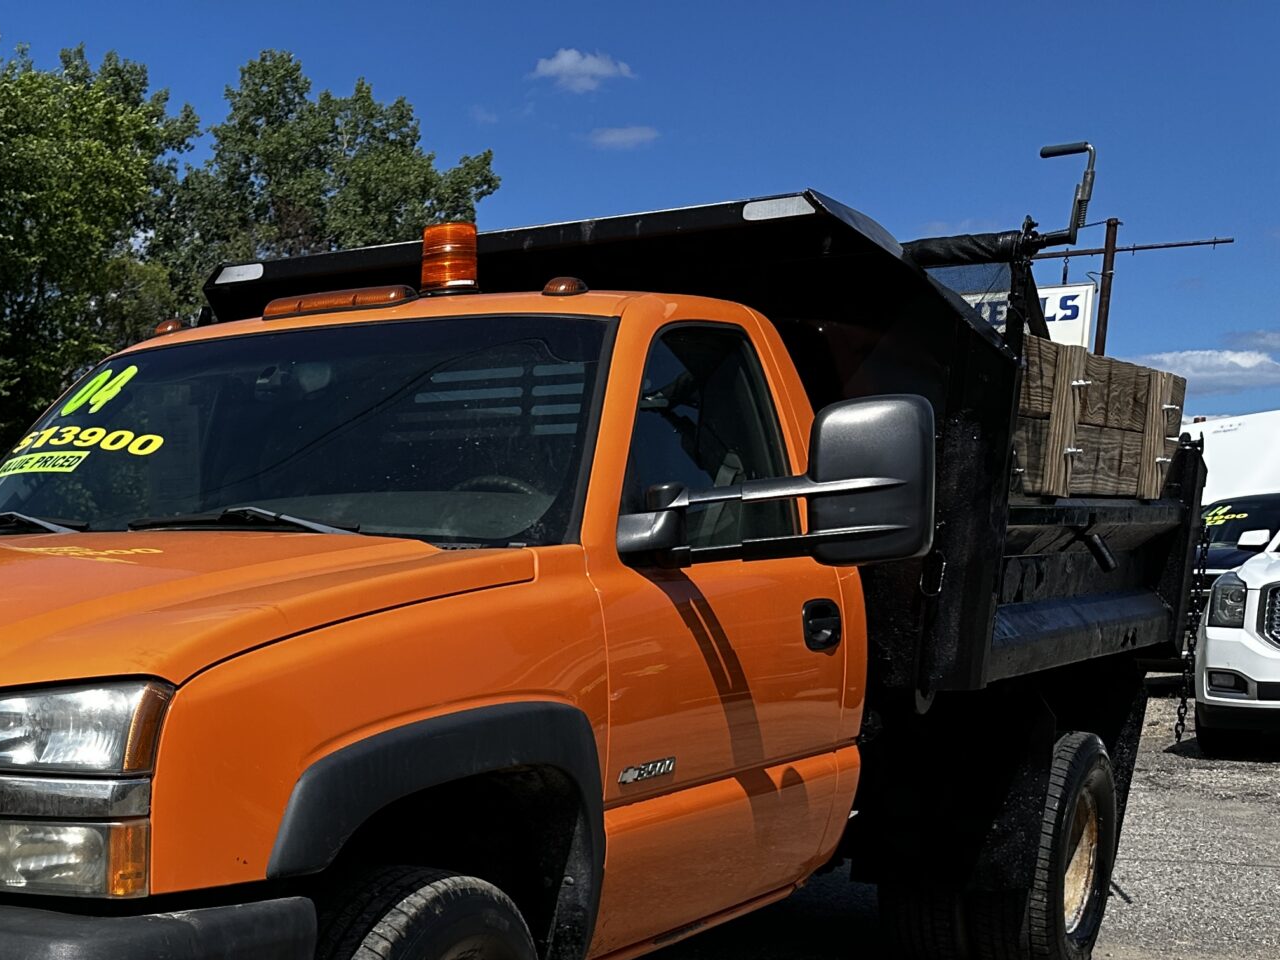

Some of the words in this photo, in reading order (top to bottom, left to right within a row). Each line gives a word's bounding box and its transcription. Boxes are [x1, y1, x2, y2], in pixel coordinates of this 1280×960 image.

[60, 365, 139, 417] 04
[12, 425, 165, 456] $13900
[29, 455, 83, 469] PRICED
